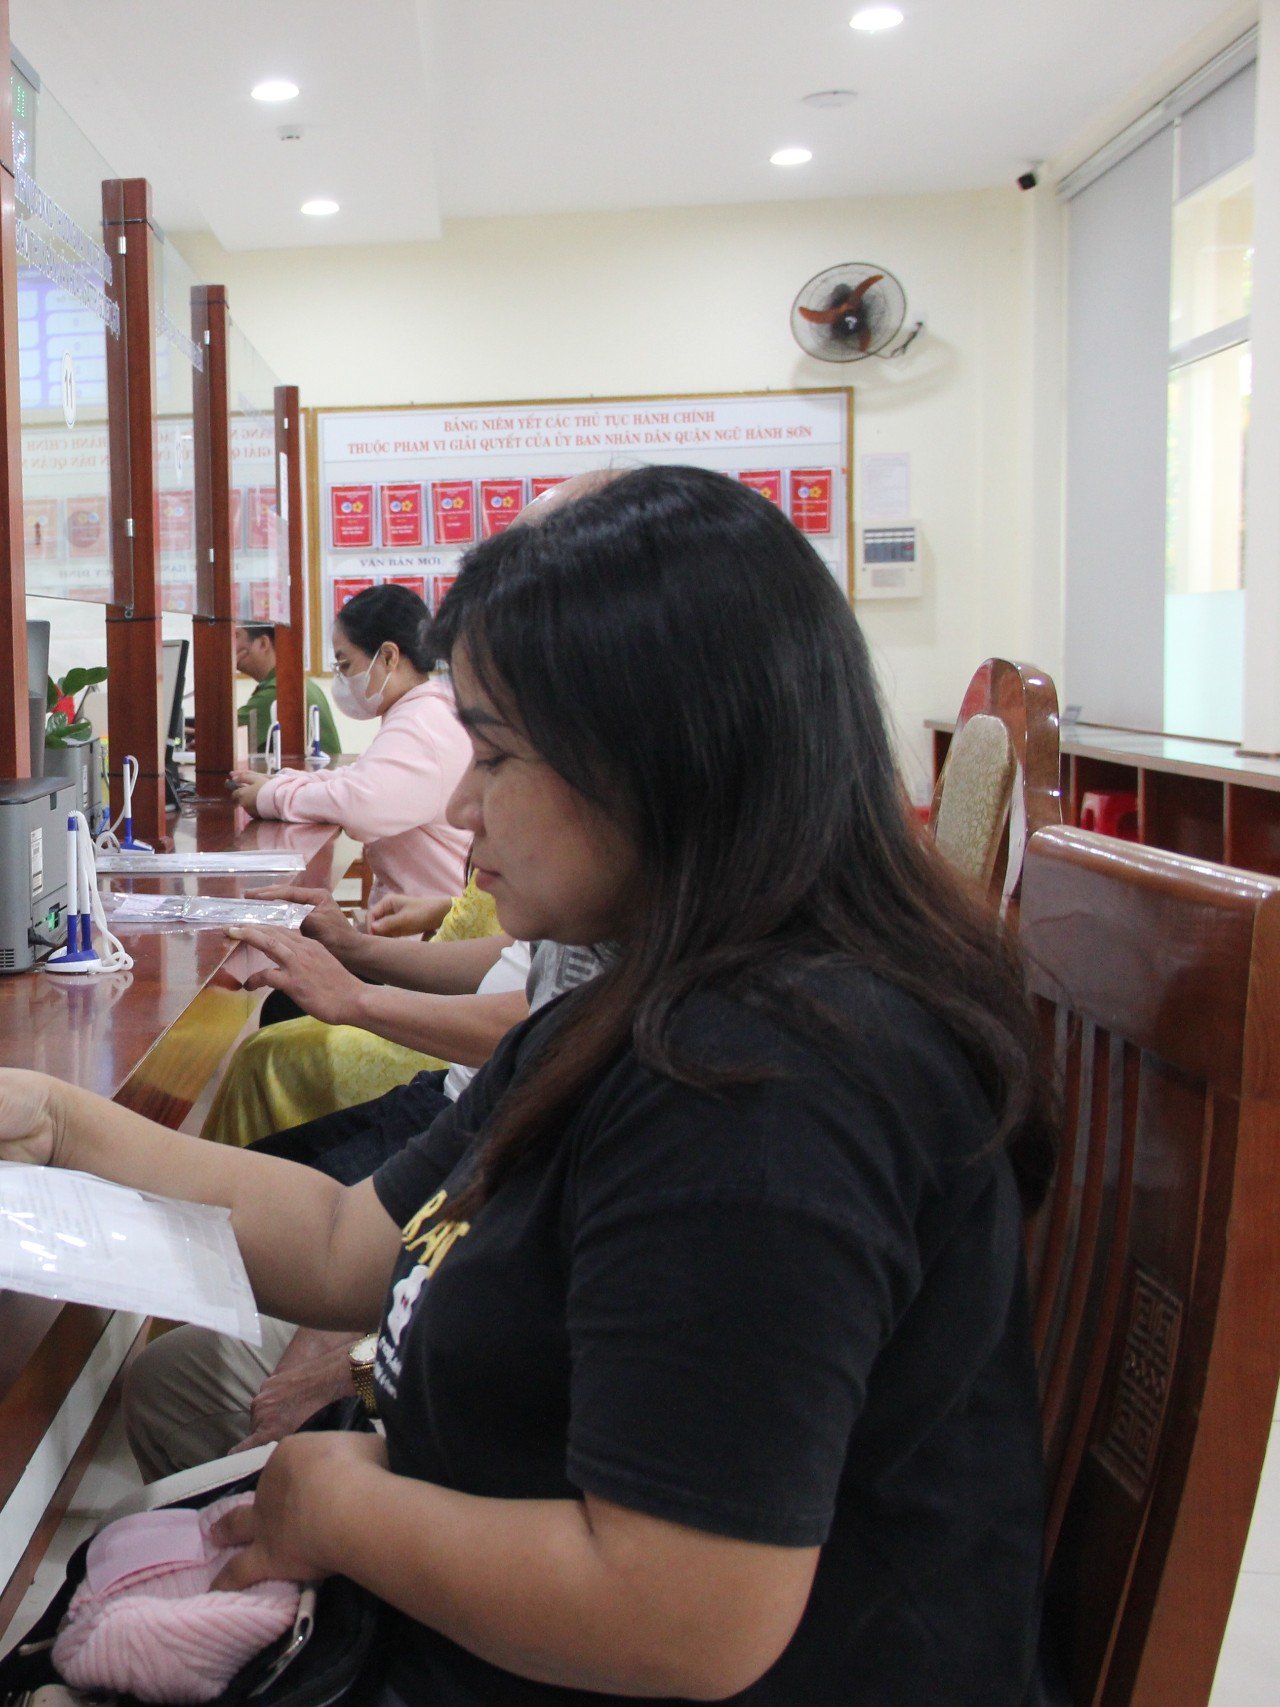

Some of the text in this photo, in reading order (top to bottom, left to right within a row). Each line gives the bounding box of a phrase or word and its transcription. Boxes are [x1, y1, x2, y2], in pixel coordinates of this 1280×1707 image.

[545, 413, 570, 428] CÁC
[633, 411, 670, 425] HÀNH
[673, 409, 715, 423] CHÍNH
[433, 440, 446, 451] VI
[575, 434, 601, 446] BAN
[605, 431, 641, 445] NHÂN
[745, 425, 783, 440] HÀNH
